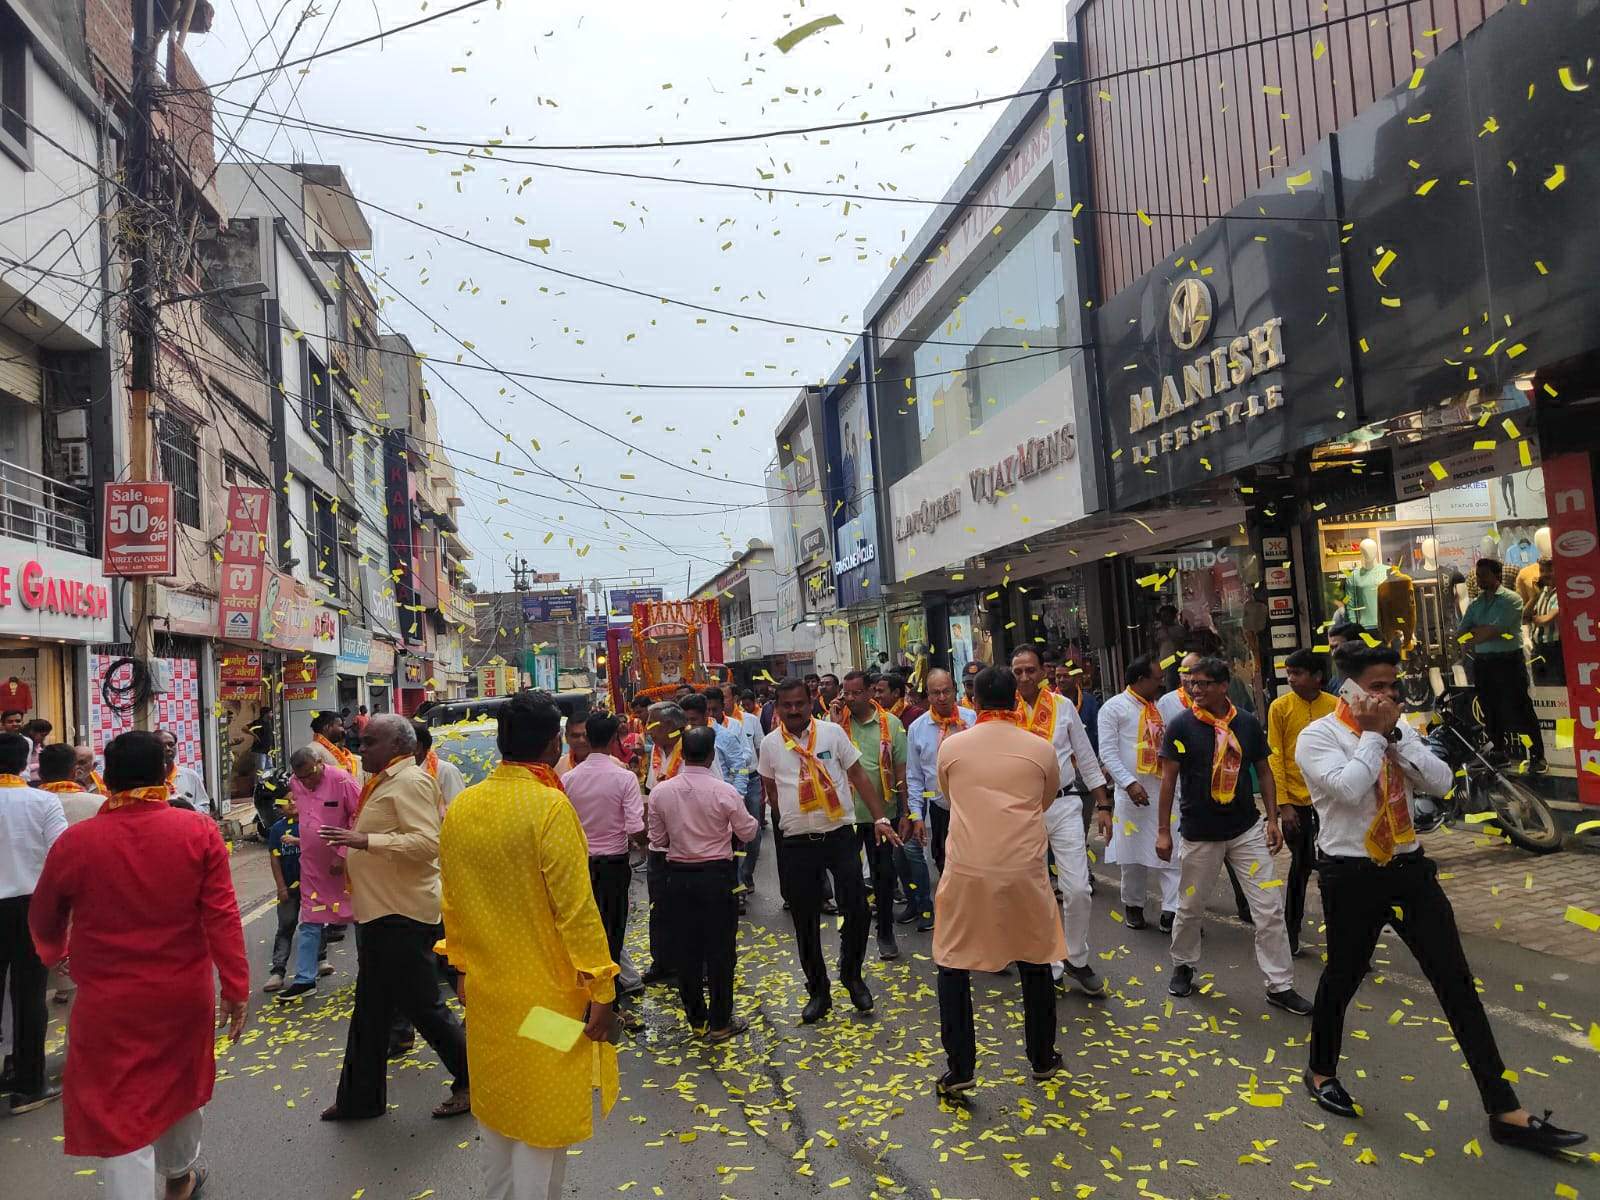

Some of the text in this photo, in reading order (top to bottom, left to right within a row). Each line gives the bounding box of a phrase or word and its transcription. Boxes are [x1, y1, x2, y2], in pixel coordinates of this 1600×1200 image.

[1129, 317, 1286, 434] MANISH
[1132, 385, 1285, 464] LIFESTYLE
[1017, 423, 1076, 480] MENS
[1451, 482, 1488, 493] OOKIES
[112, 489, 164, 504] Sale Upto
[150, 531, 168, 542] OFF
[134, 555, 166, 563] GANESH
[18, 560, 108, 619] GANESH
[1531, 700, 1557, 708] ILLER
